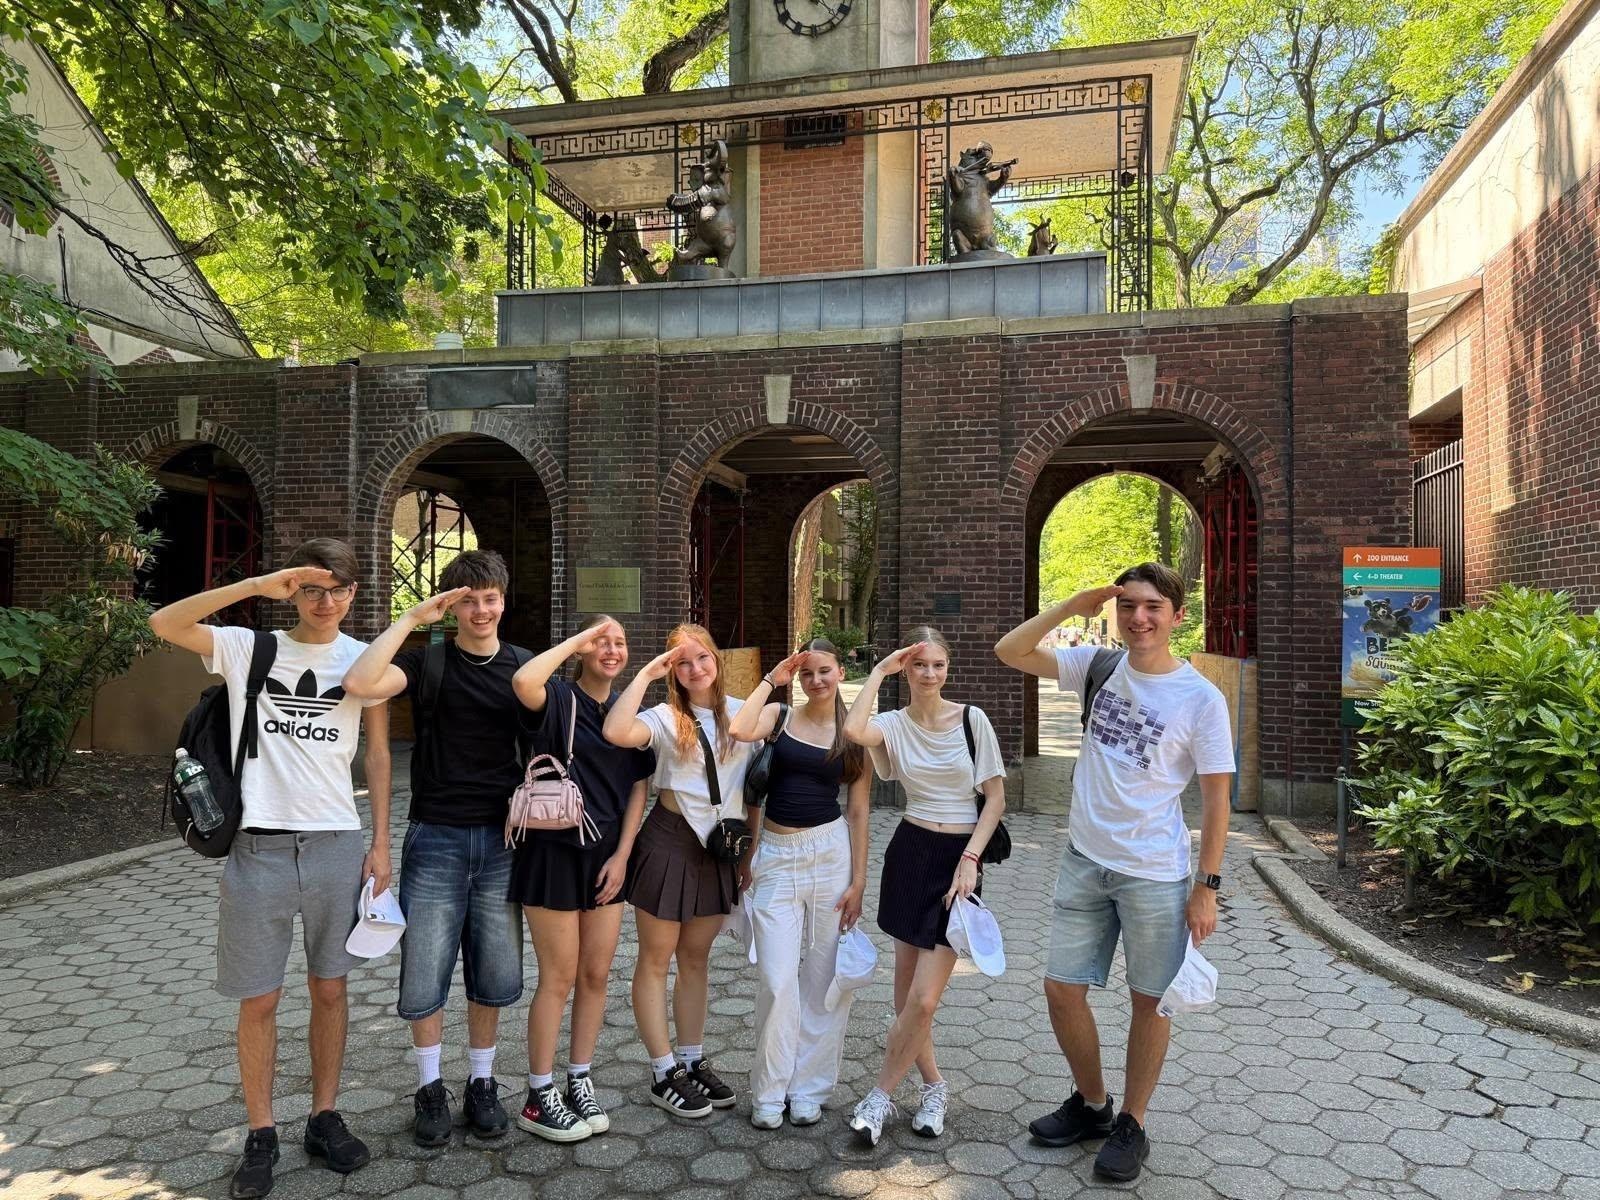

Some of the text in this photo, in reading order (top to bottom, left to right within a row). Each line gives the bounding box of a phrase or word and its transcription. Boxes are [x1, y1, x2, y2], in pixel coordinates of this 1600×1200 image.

[1367, 554, 1409, 562] ZOO ENTRANCE
[264, 719, 340, 742] adidas
